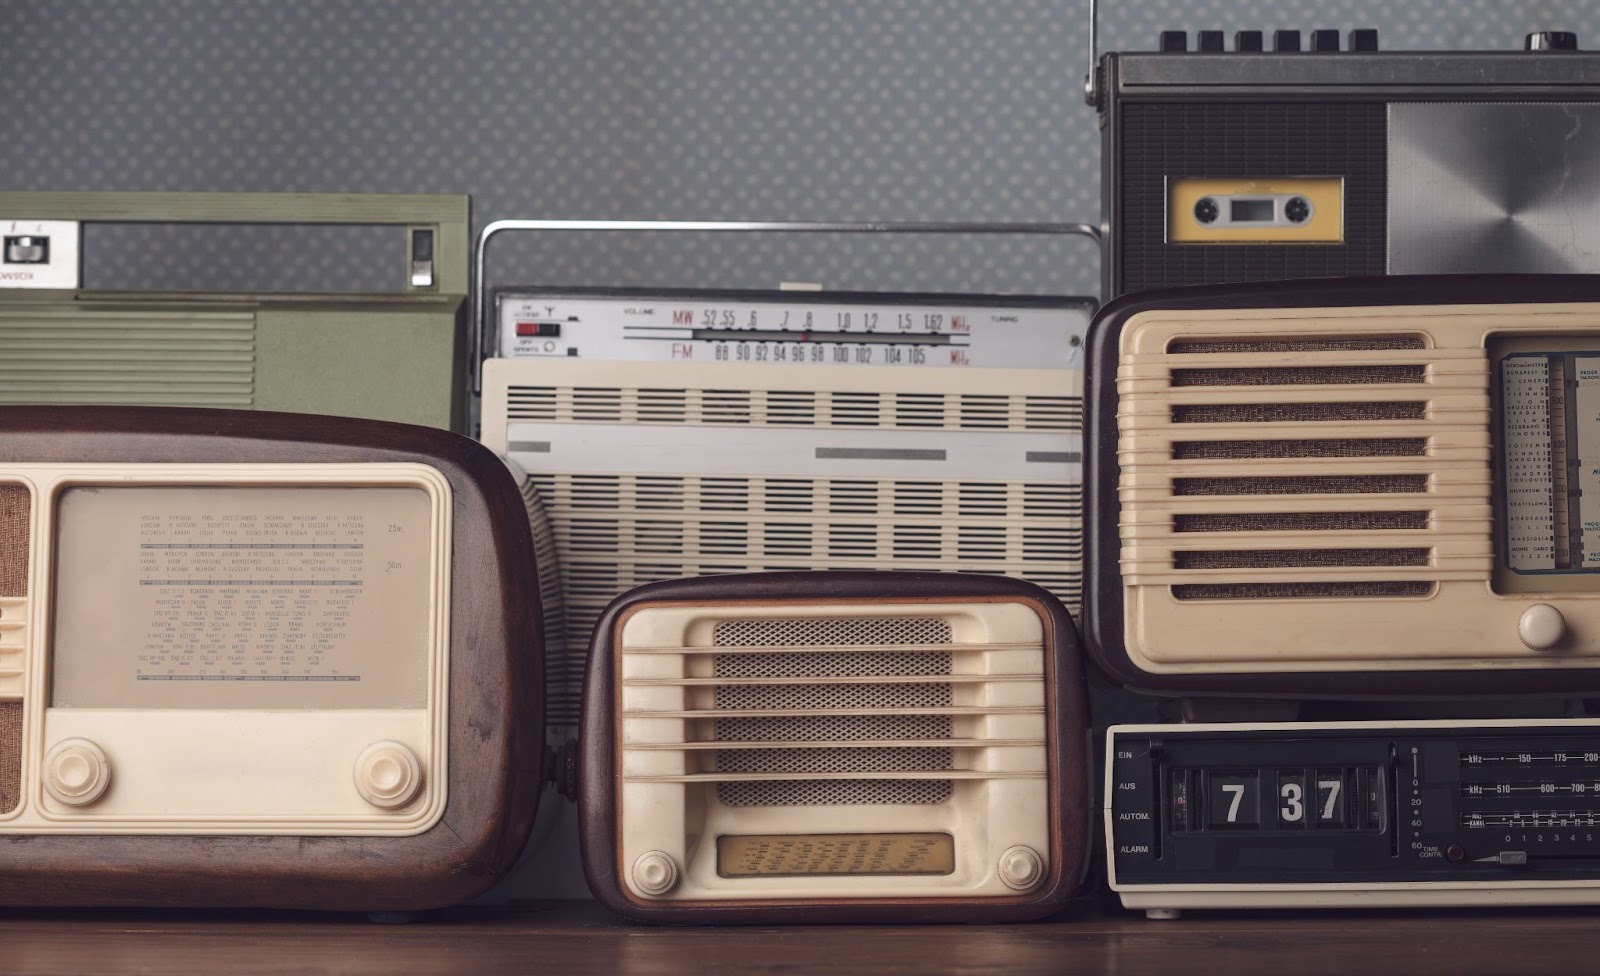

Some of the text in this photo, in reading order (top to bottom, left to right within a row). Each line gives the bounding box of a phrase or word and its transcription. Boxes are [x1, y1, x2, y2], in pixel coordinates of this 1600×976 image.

[672, 310, 694, 325] MW
[701, 310, 717, 326] .52
[719, 310, 736, 326] .55
[747, 311, 757, 326] .6
[780, 311, 790, 327] .7
[802, 312, 812, 328] .8
[838, 312, 851, 328] 1.0
[864, 313, 878, 329] 1.2
[898, 314, 912, 330] 1.5
[672, 343, 693, 359] FM
[716, 345, 729, 360] 88
[736, 344, 750, 360] 90
[756, 345, 768, 361] 92
[774, 346, 786, 361] 94
[792, 346, 804, 362] 96
[812, 346, 824, 362] 98
[833, 347, 849, 362] 100
[856, 348, 872, 363] 102
[884, 348, 901, 364] 104
[909, 348, 925, 364] 105
[1468, 753, 1598, 763] kHz 150 175 200
[1470, 786, 1483, 794] kHz
[1497, 785, 1510, 793] 510
[1541, 784, 1554, 792] 600
[1572, 784, 1585, 792] 700
[1222, 784, 1245, 822] 7
[1119, 812, 1150, 820] AUTOM.
[1120, 845, 1148, 853] ALARM
